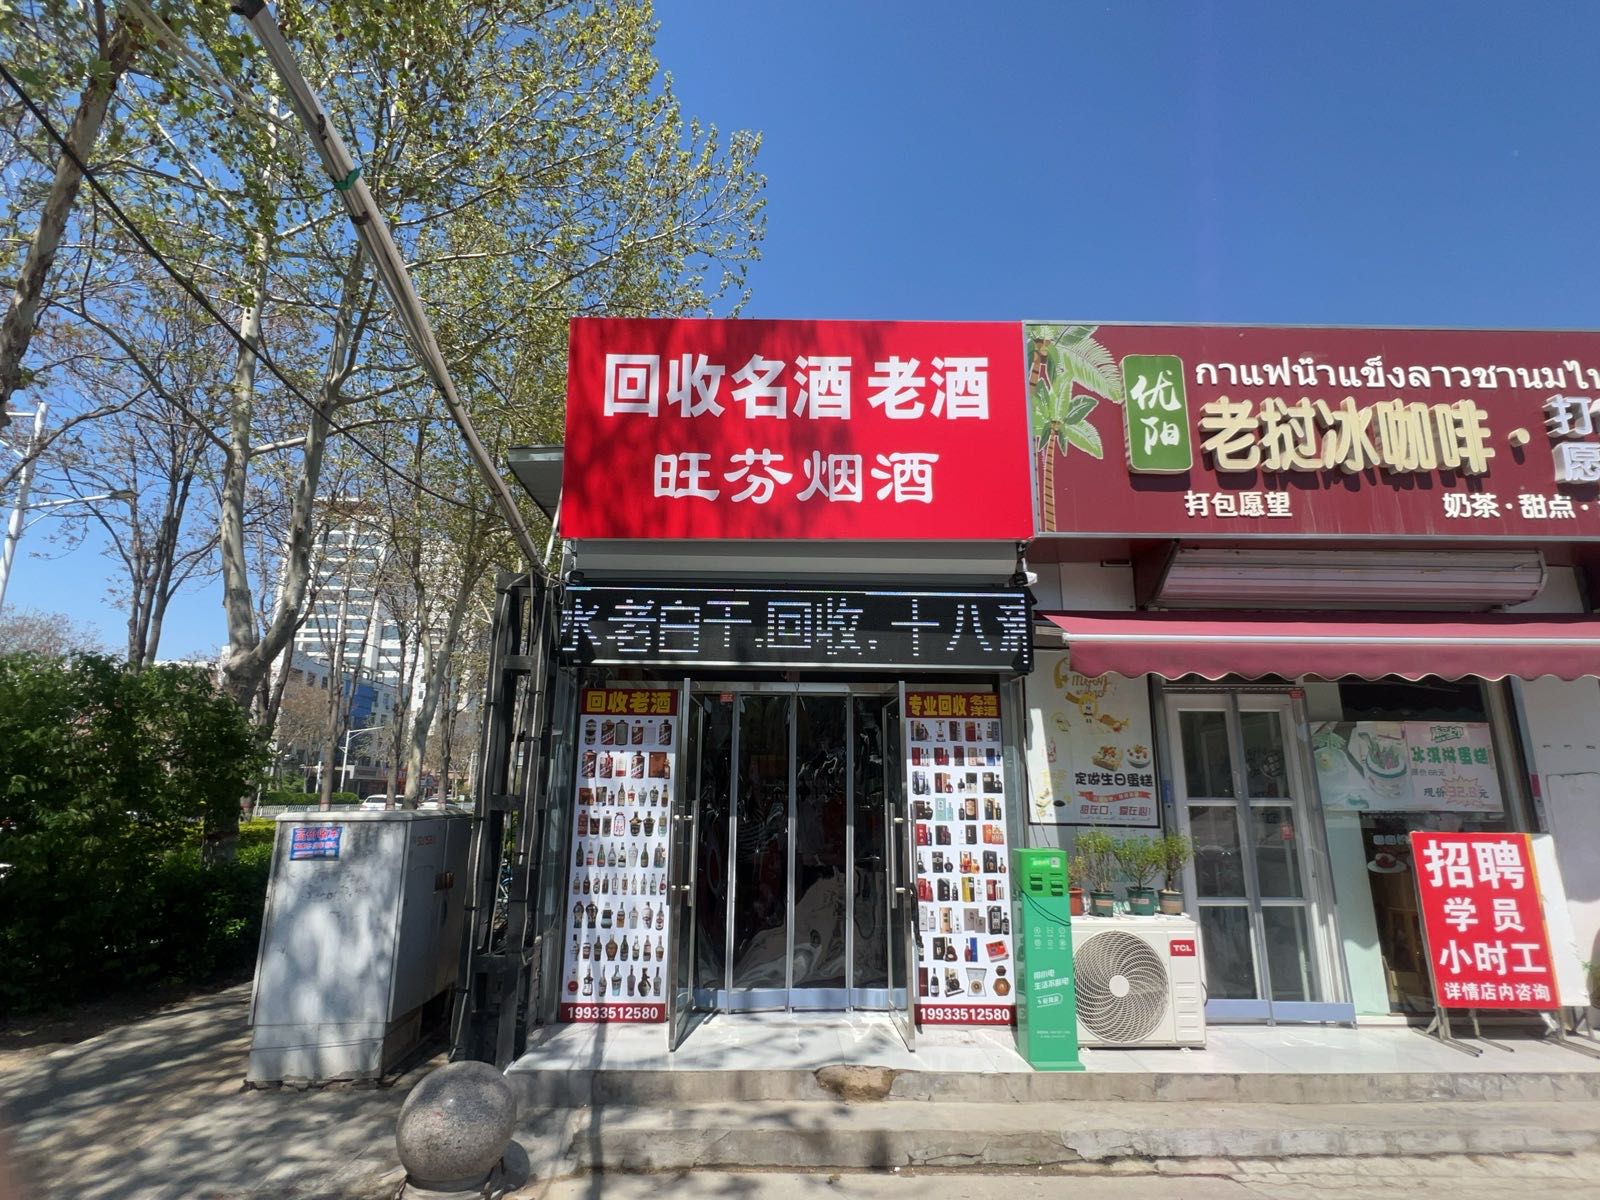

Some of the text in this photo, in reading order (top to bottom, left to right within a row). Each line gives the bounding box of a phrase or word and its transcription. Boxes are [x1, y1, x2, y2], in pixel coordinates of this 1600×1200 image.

[603, 353, 990, 421] 回收名酒 老酒
[1130, 370, 1182, 456] 优阳
[1543, 394, 1600, 435] 打
[653, 448, 940, 504] 旺芬烟酒
[1184, 490, 1293, 517] 打包愿望
[586, 691, 672, 714] 回收老酒
[909, 694, 968, 717] 专业回收
[970, 694, 997, 706] 名酒
[1074, 771, 1153, 787] 定做生日蛋糕
[1423, 840, 1526, 889] 招聘
[1443, 897, 1526, 933] 学员
[1172, 944, 1193, 952] TCL
[1439, 940, 1547, 976] 小时工
[1444, 982, 1551, 1002] 详情店内咨询
[567, 1006, 659, 1020] 19933512580
[920, 1007, 1010, 1021] 19933512580
